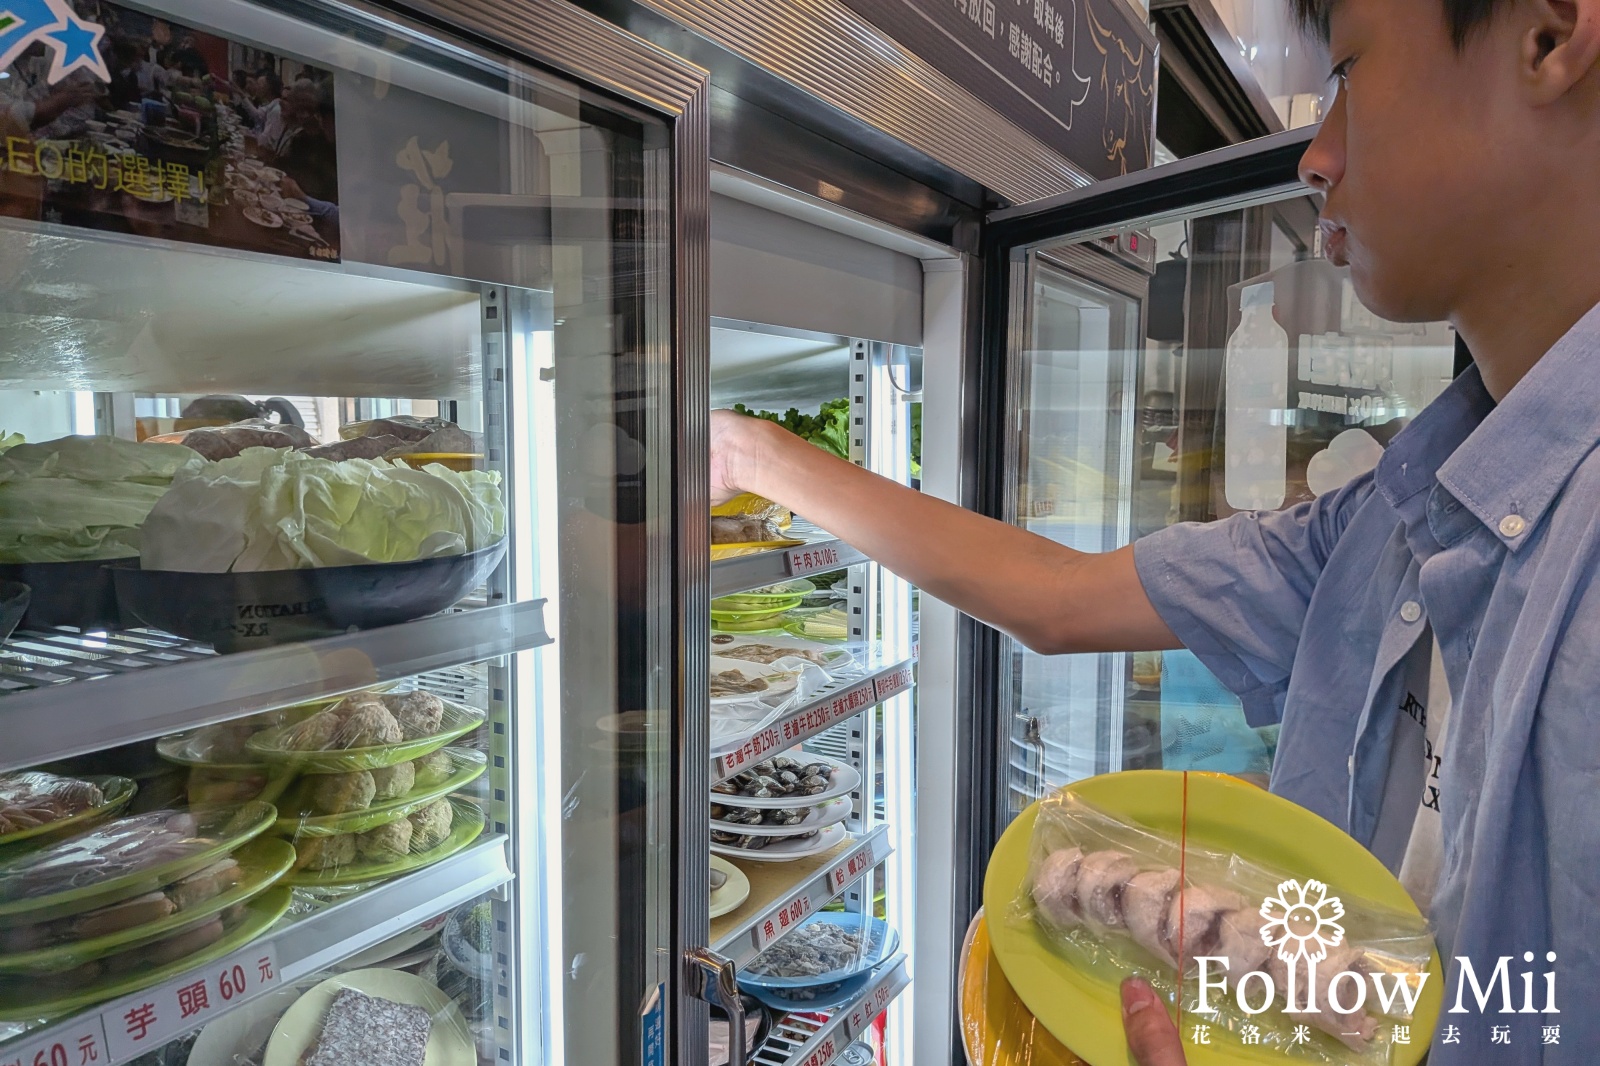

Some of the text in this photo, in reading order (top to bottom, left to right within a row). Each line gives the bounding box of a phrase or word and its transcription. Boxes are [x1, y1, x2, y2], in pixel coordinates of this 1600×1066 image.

[0, 136, 205, 204] EO的選擇!
[793, 548, 838, 570] 牛肉丸100元
